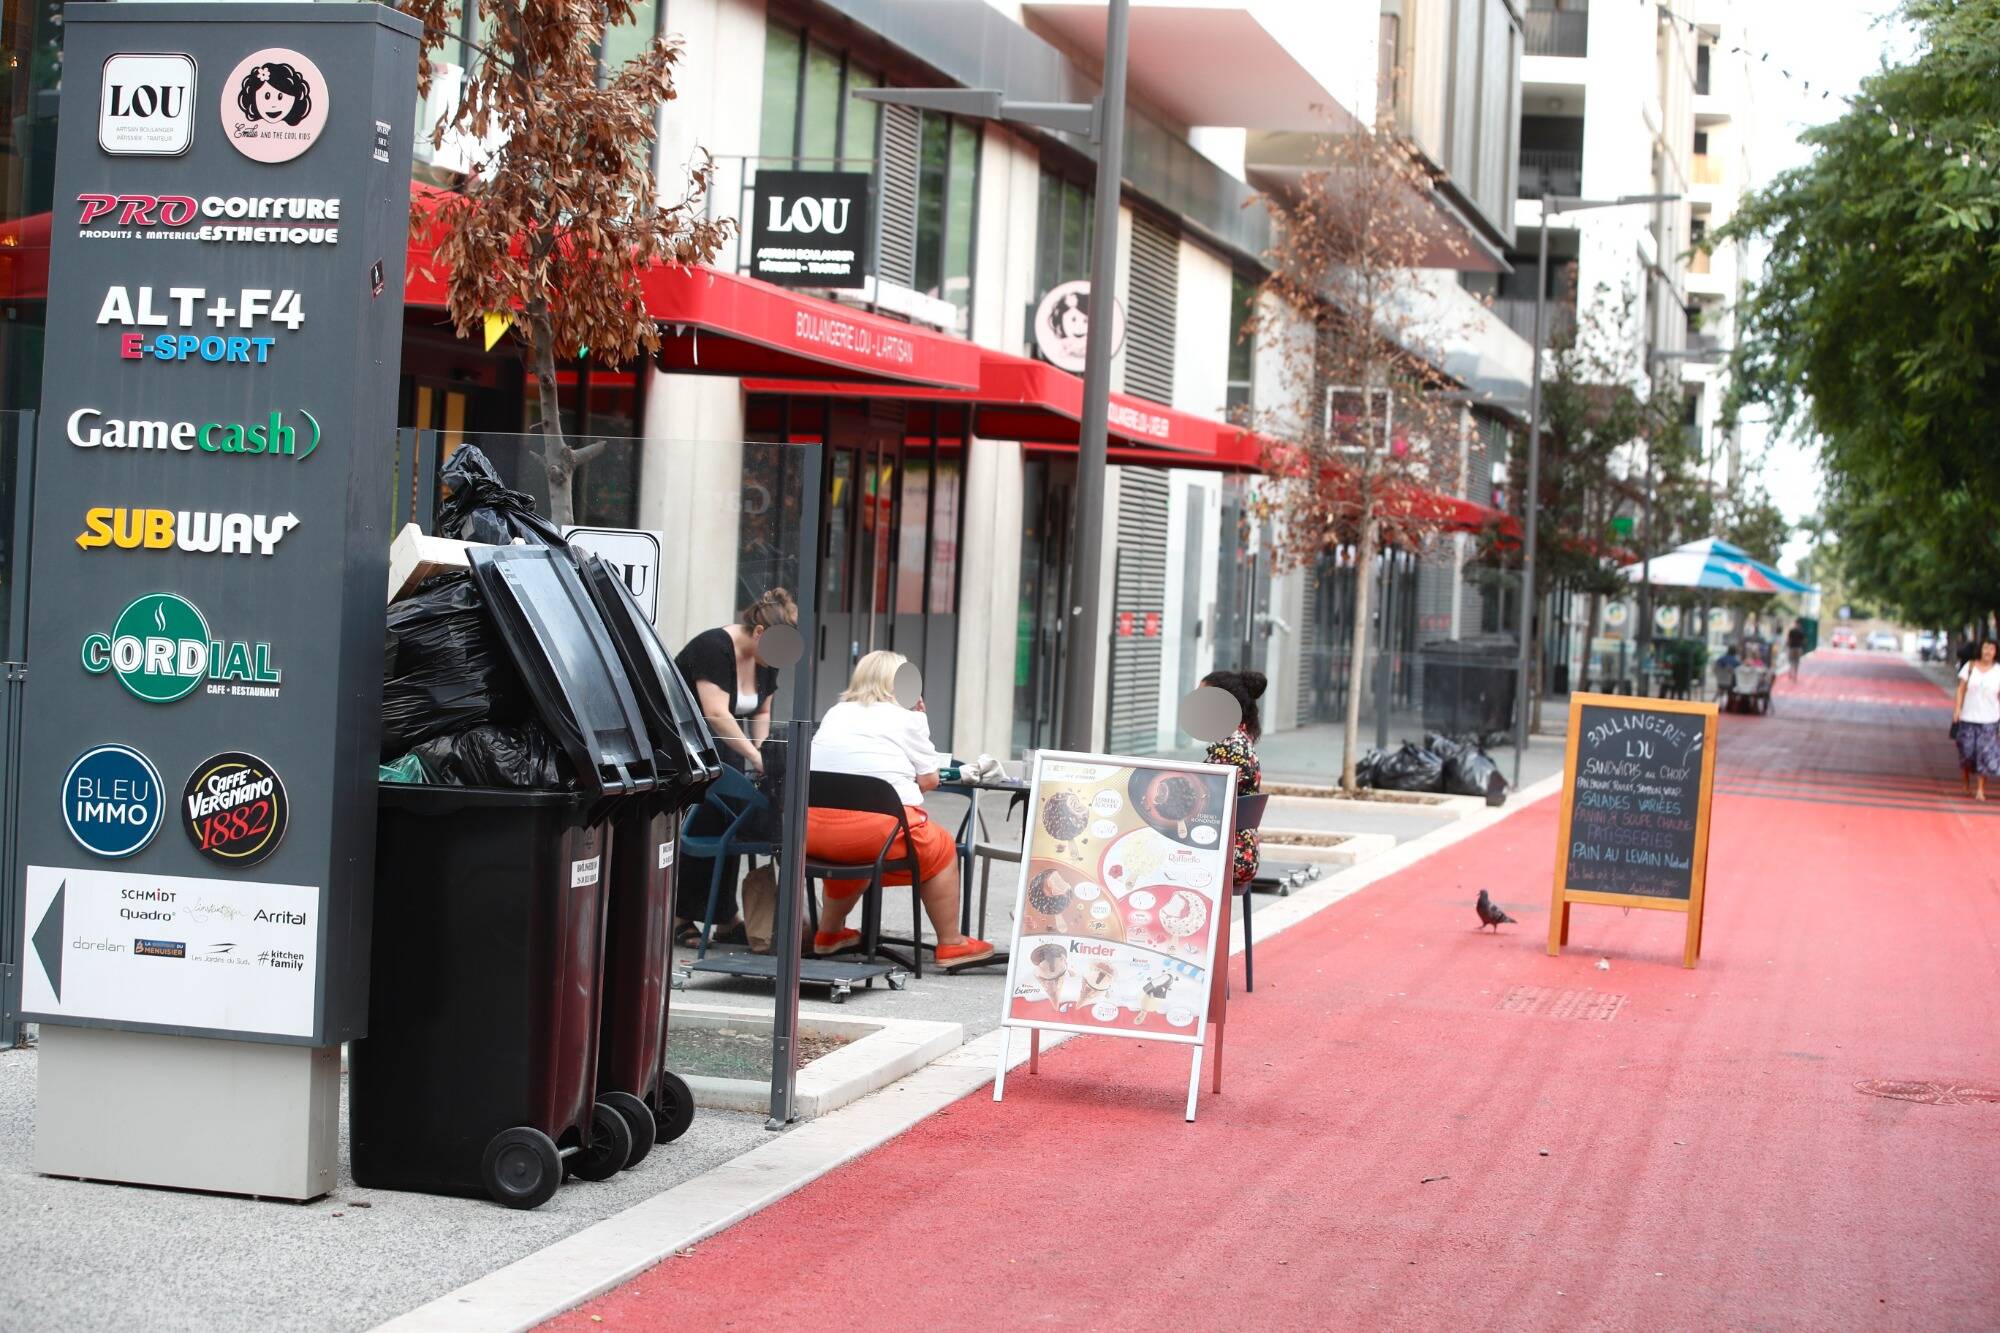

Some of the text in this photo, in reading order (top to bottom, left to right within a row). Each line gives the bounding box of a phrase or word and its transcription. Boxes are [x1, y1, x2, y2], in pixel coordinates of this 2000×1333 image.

[108, 85, 185, 118] LOU
[273, 131, 282, 140] THE
[77, 193, 340, 226] PRO COIFFURE
[767, 196, 851, 234] LOU
[79, 230, 201, 241] PRODUITS & MATERIELS
[200, 226, 339, 245] ESTHETIQUE
[96, 285, 305, 331] ALT+F4
[796, 311, 855, 349] BOULANGERIE
[855, 328, 872, 354] LOU
[121, 332, 276, 364] E-SPORT
[75, 507, 300, 556] SUBWAY
[81, 631, 282, 684] CORDIAL
[207, 684, 280, 698] CAFE RESTAURANT
[1587, 713, 1687, 748] BOULANGERIE
[1626, 740, 1655, 759] LOU
[77, 777, 149, 802] BLEU
[188, 777, 273, 820] VERGNANO
[1579, 791, 1630, 810] SALADES
[77, 801, 148, 826] IMMO
[200, 800, 269, 850] 1882
[1572, 841, 1600, 860] PAIN
[1604, 847, 1619, 862] AU
[1625, 848, 1661, 867] LEVAIN
[253, 909, 306, 925] Arrital
[73, 936, 125, 952] dorelan
[144, 947, 183, 956] MENUISIER
[270, 958, 304, 971] family
